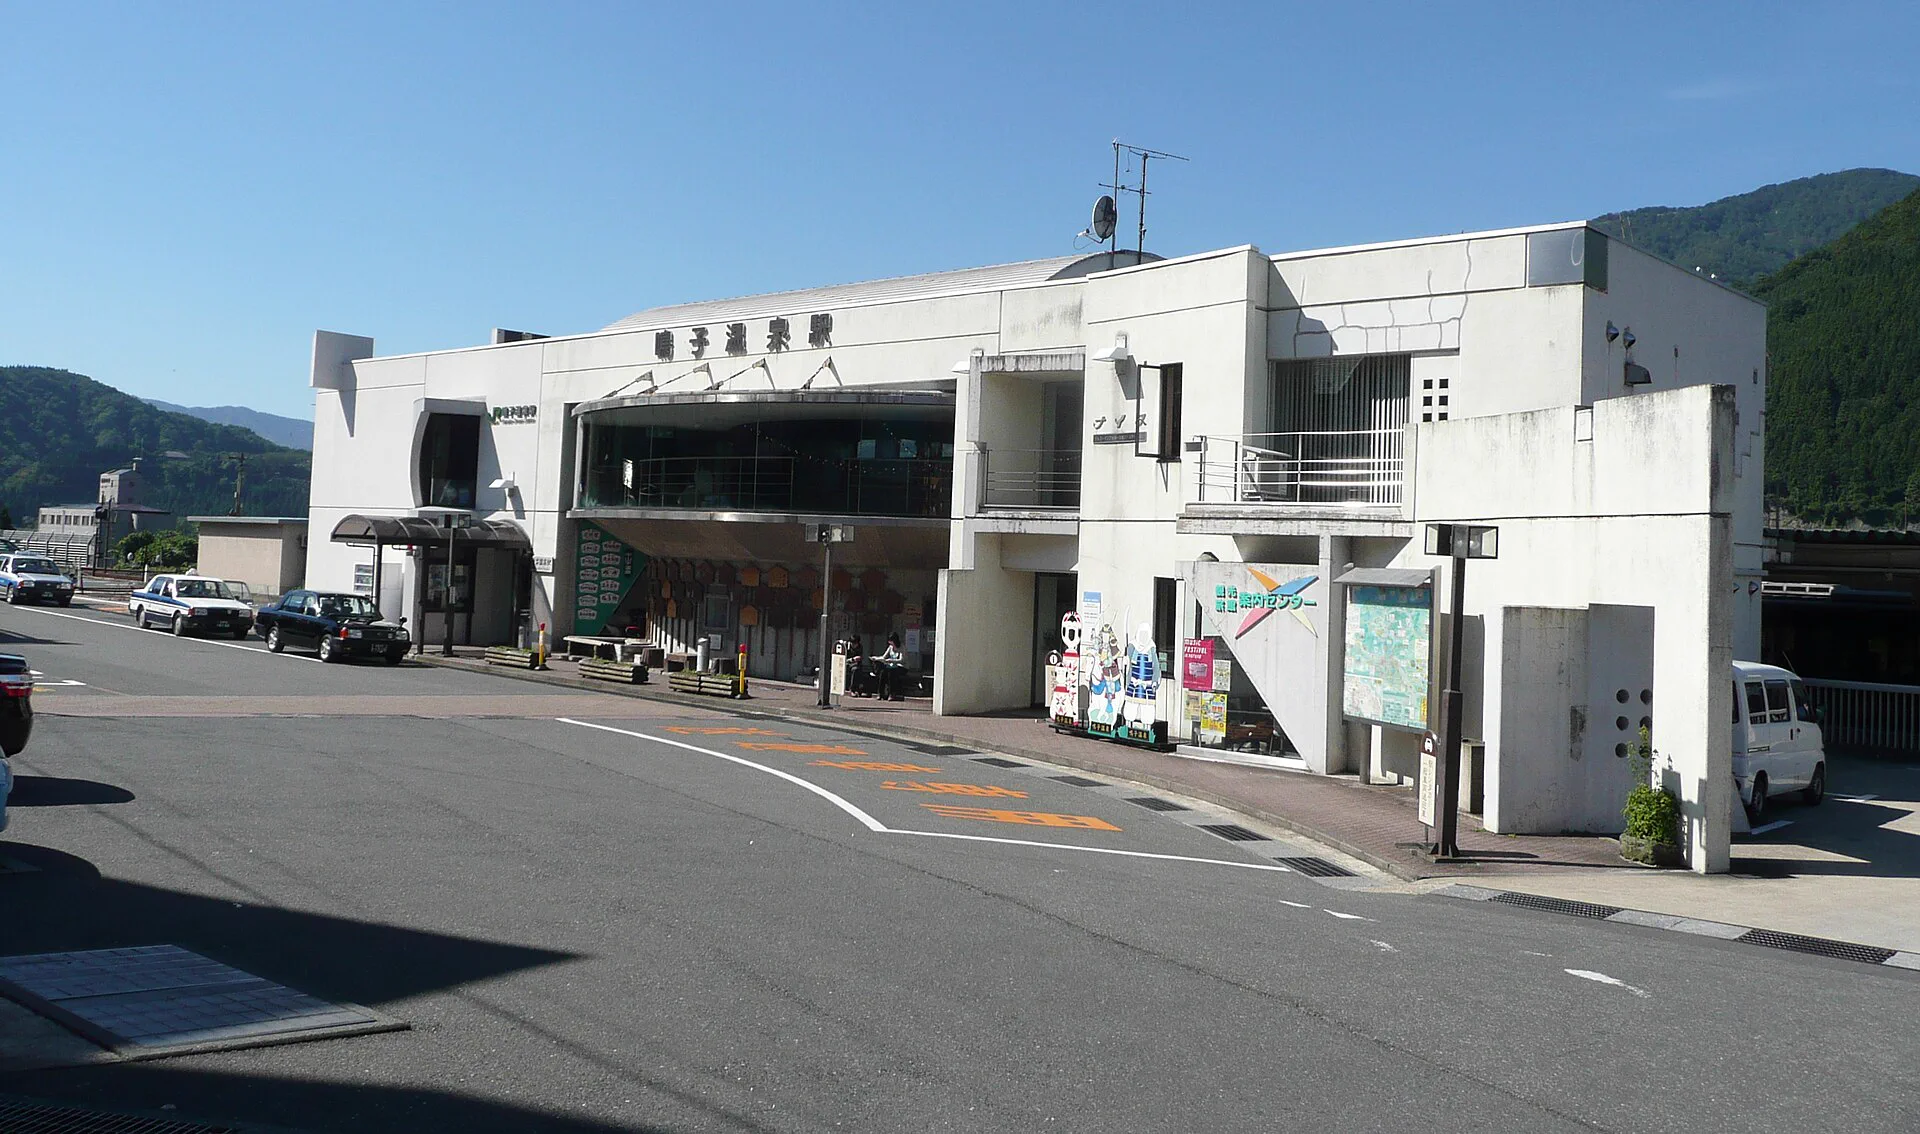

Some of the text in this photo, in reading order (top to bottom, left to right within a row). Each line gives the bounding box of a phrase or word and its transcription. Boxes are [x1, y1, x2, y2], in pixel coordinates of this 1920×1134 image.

[1239, 591, 1318, 610] 案内センター
